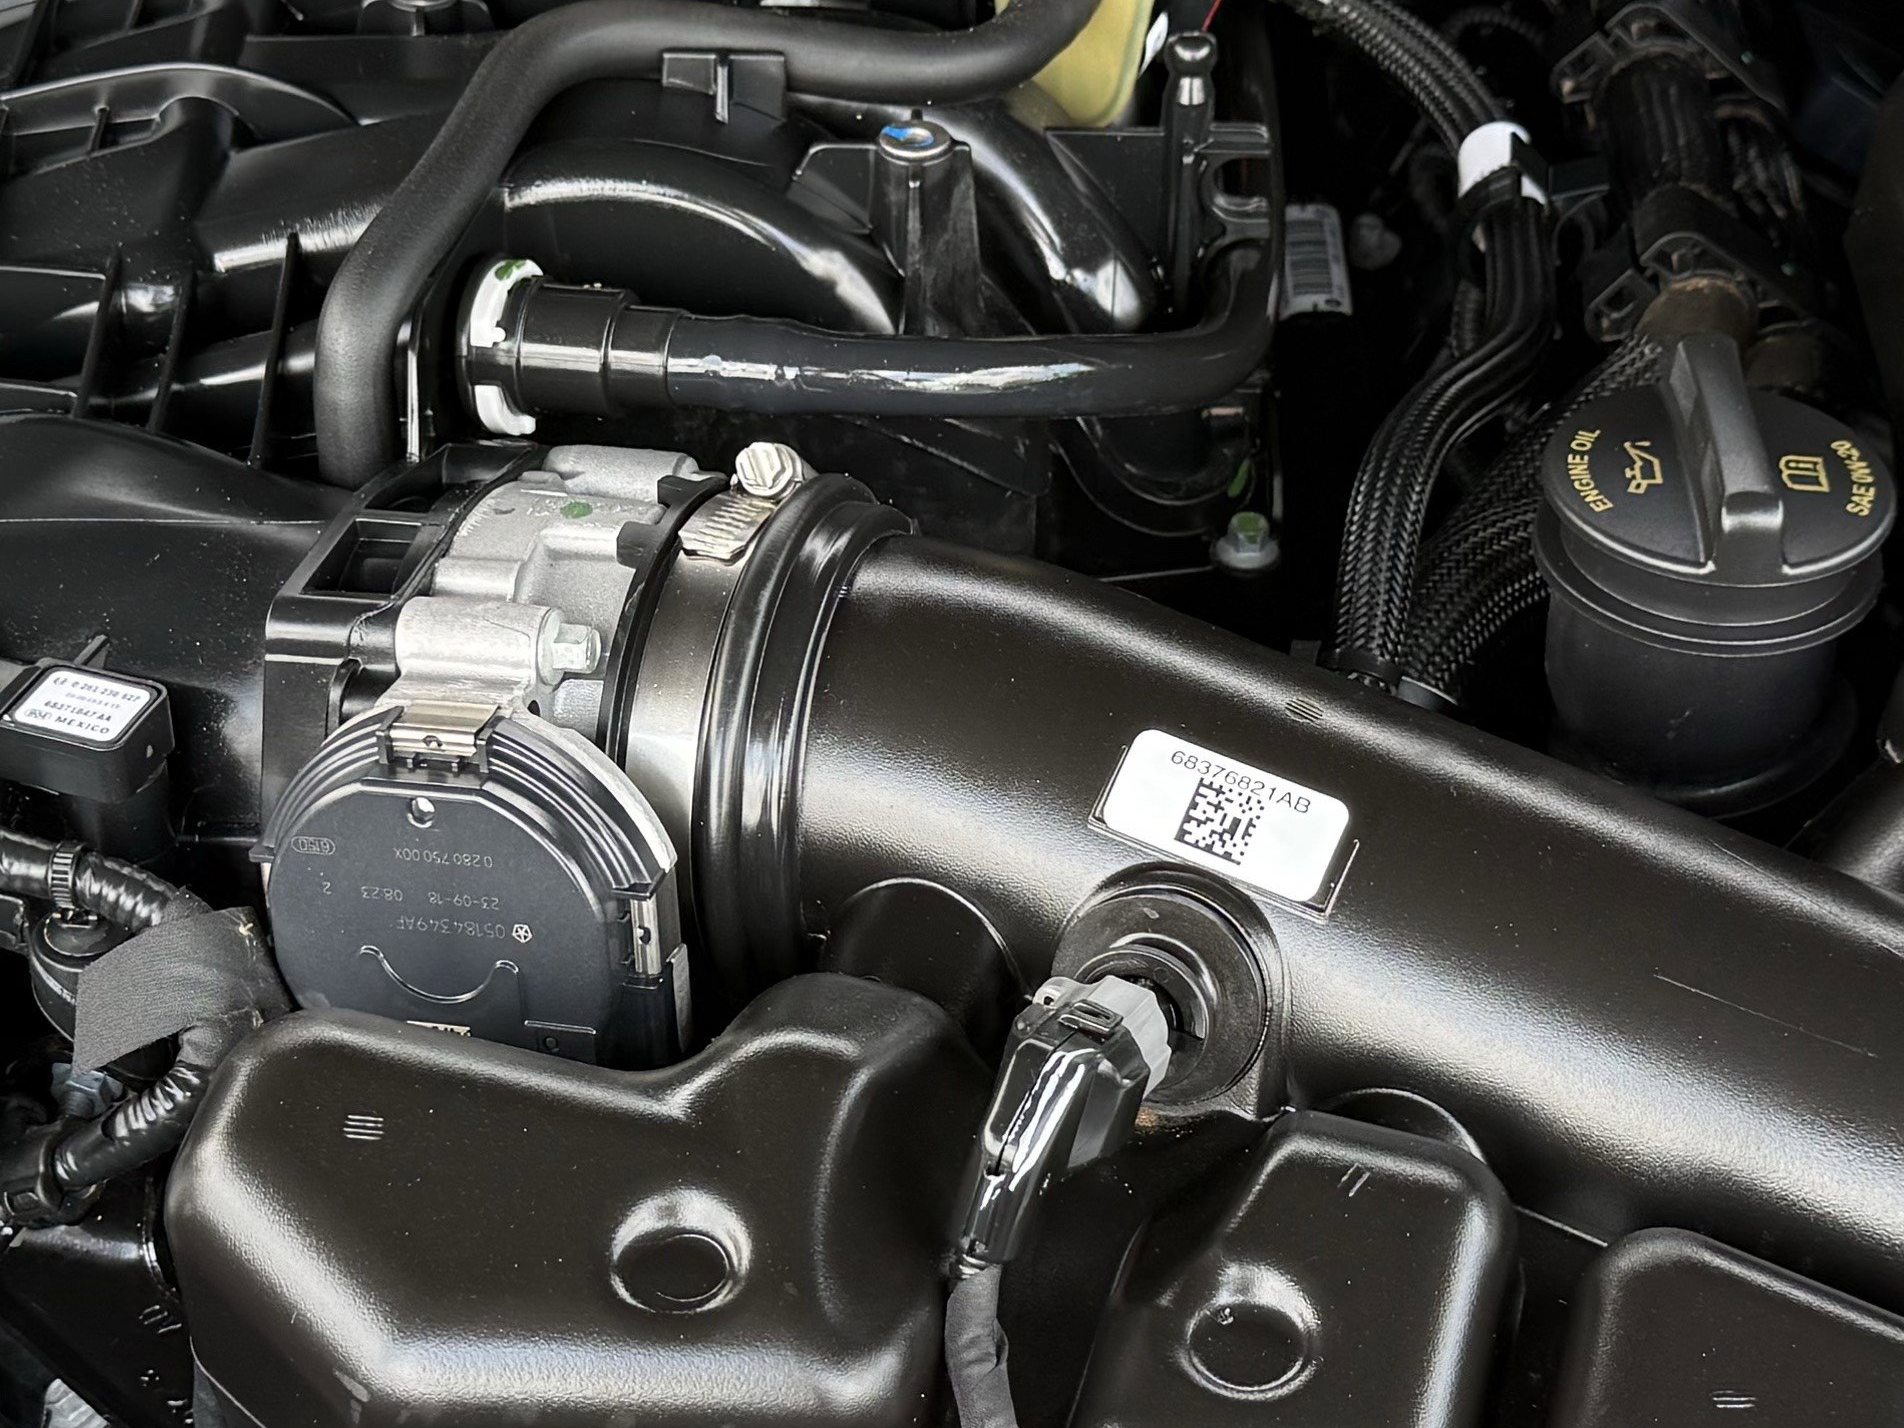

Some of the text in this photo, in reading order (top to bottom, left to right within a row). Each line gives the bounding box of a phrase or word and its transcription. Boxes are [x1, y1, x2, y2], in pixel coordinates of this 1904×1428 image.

[1567, 429, 1614, 512] ENGINE OIL
[1830, 440, 1876, 517] SAE 0W-20
[54, 716, 110, 734] MEXICO
[1170, 750, 1312, 814] 68376821AB
[427, 891, 500, 911] 23-09-18
[396, 915, 506, 939] 05184349AF
